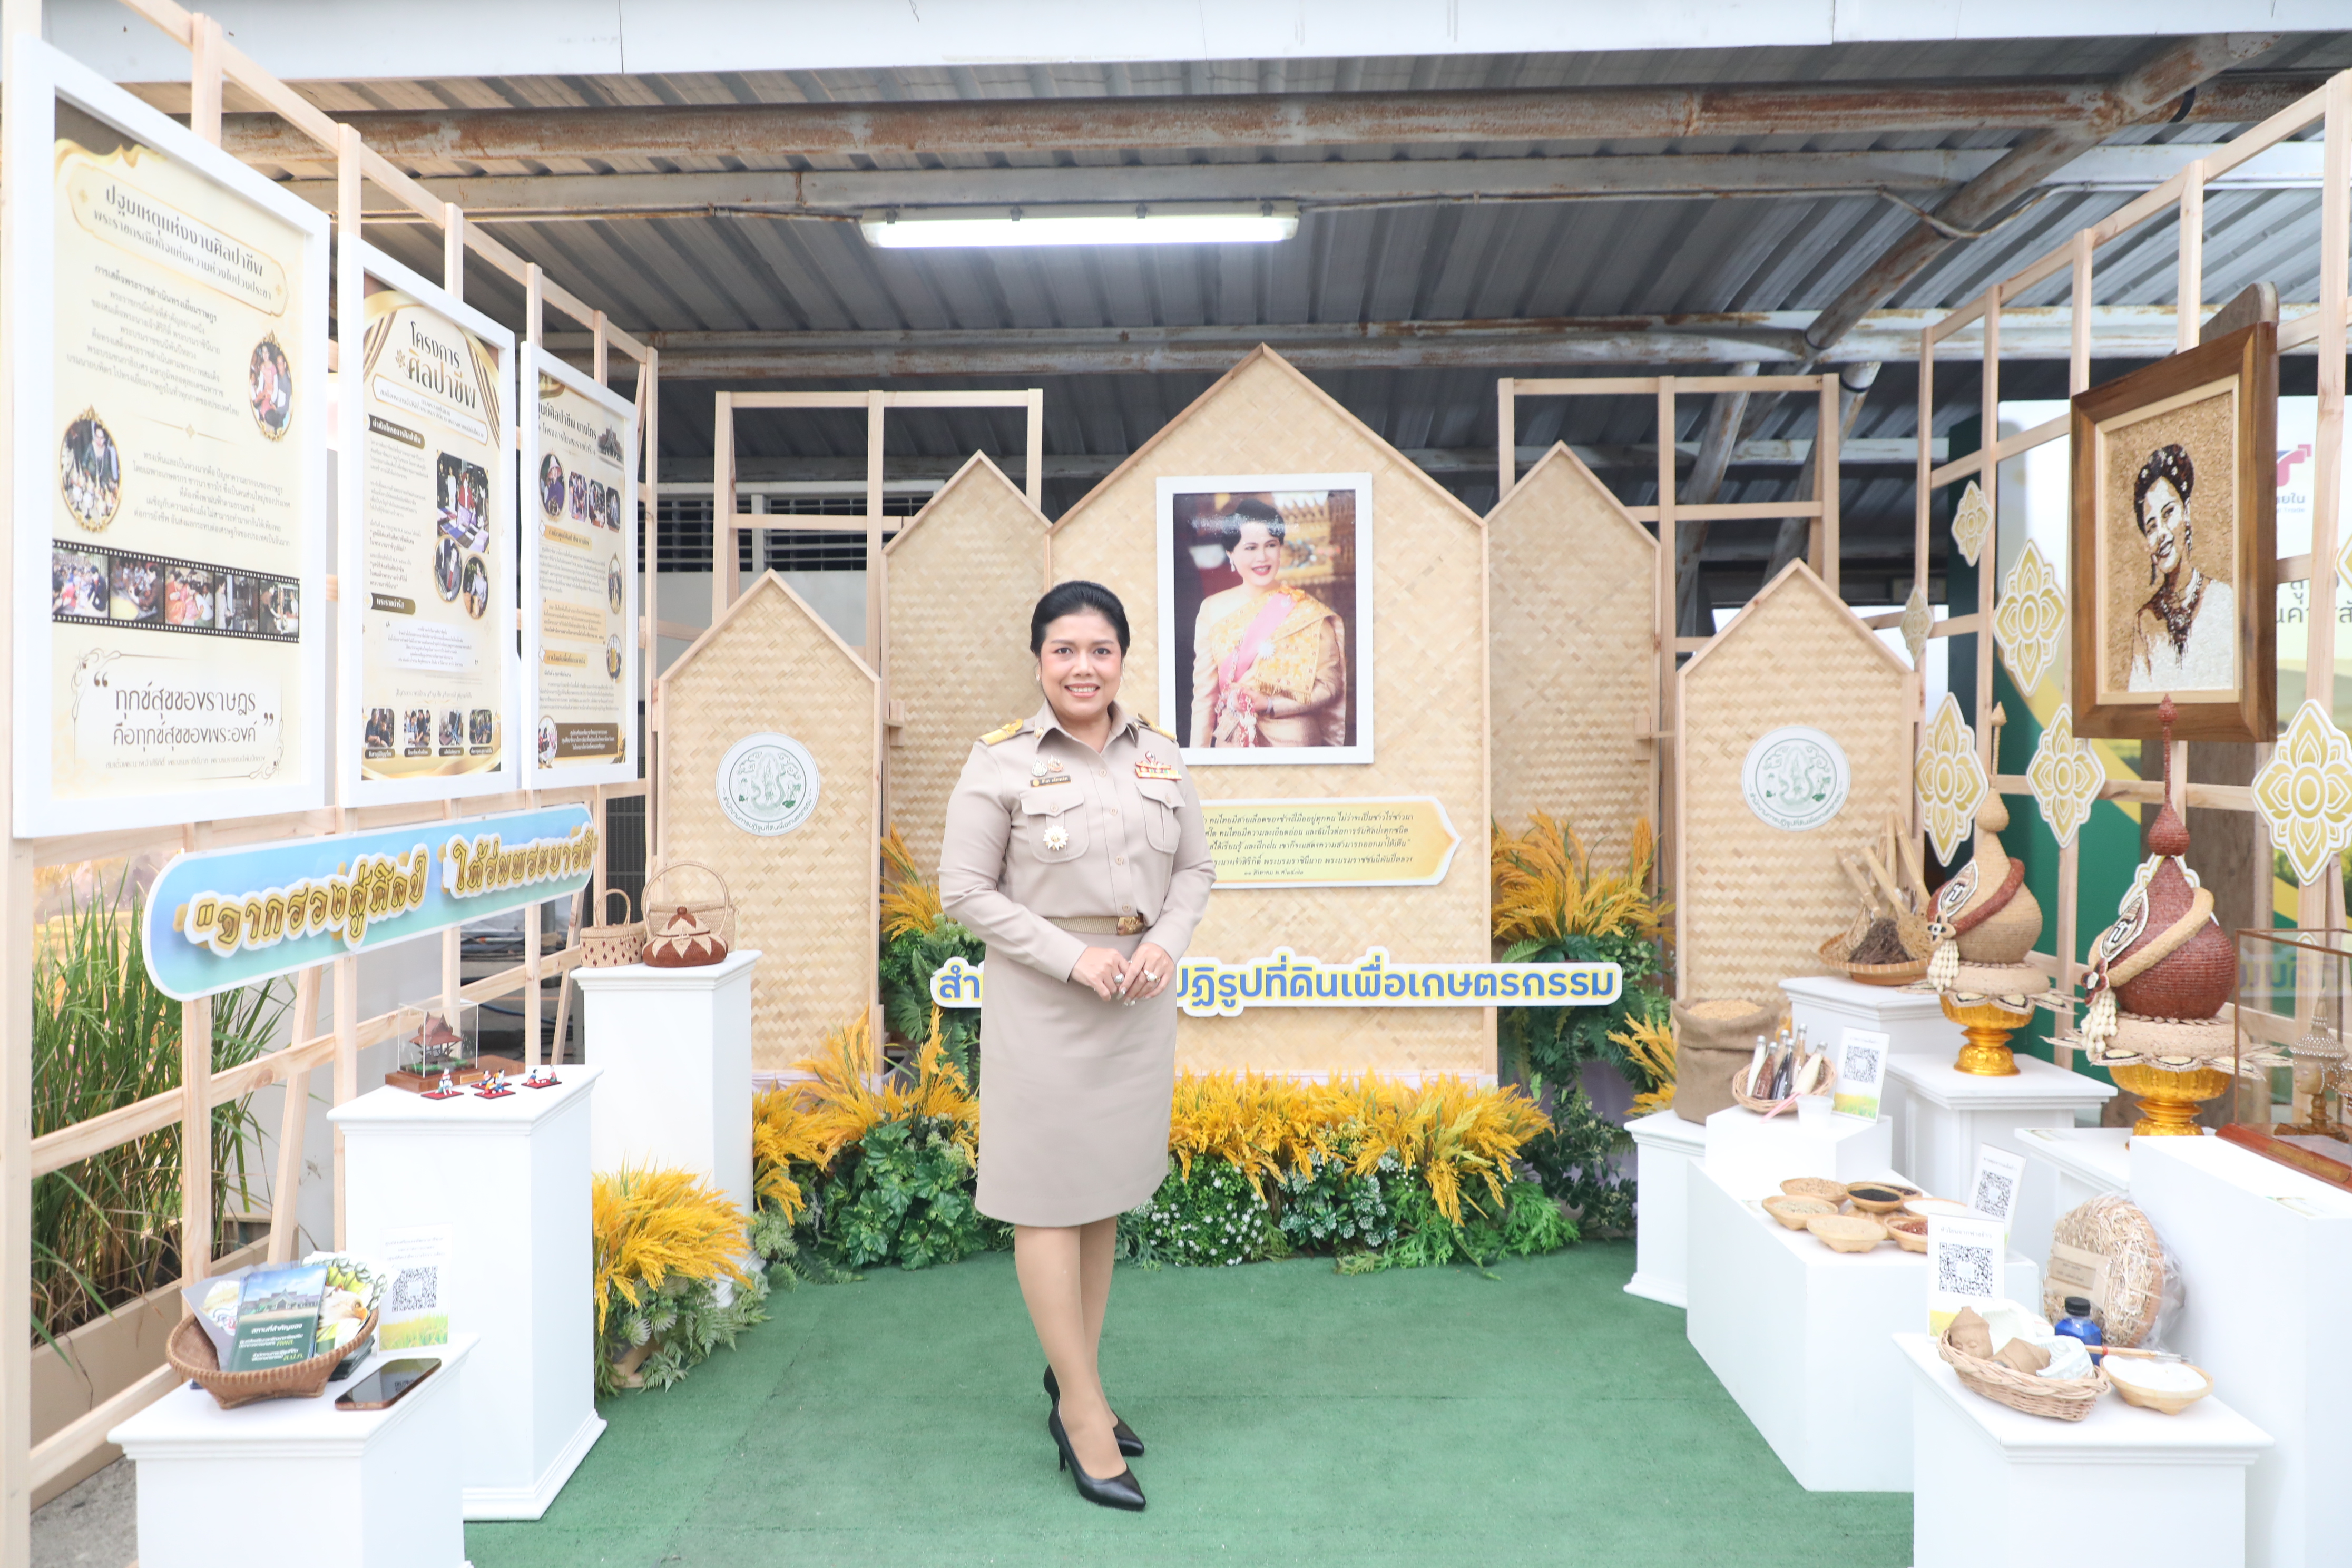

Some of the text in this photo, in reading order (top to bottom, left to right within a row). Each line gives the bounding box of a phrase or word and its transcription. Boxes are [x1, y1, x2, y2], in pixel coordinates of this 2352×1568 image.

[106, 184, 263, 277] ปฐมเหตุแห่งงานศิลปาชีพ
[94, 209, 271, 300] พระราชกรณียกิจแห่งความห่วงใยปวงประชา
[410, 321, 460, 369] โครงการ
[409, 348, 476, 410] ศิลปาชีพ
[115, 680, 256, 720] ทุกข์สุขของราษฎร
[113, 721, 257, 752] คือทุกข์สุขของพระองค์
[1209, 840, 1242, 853] สได้เรียนรู้
[1213, 853, 1263, 865] ระนางเจ้าสิริกิติ์
[1264, 855, 1322, 865] พระบรมราชินีนาถ
